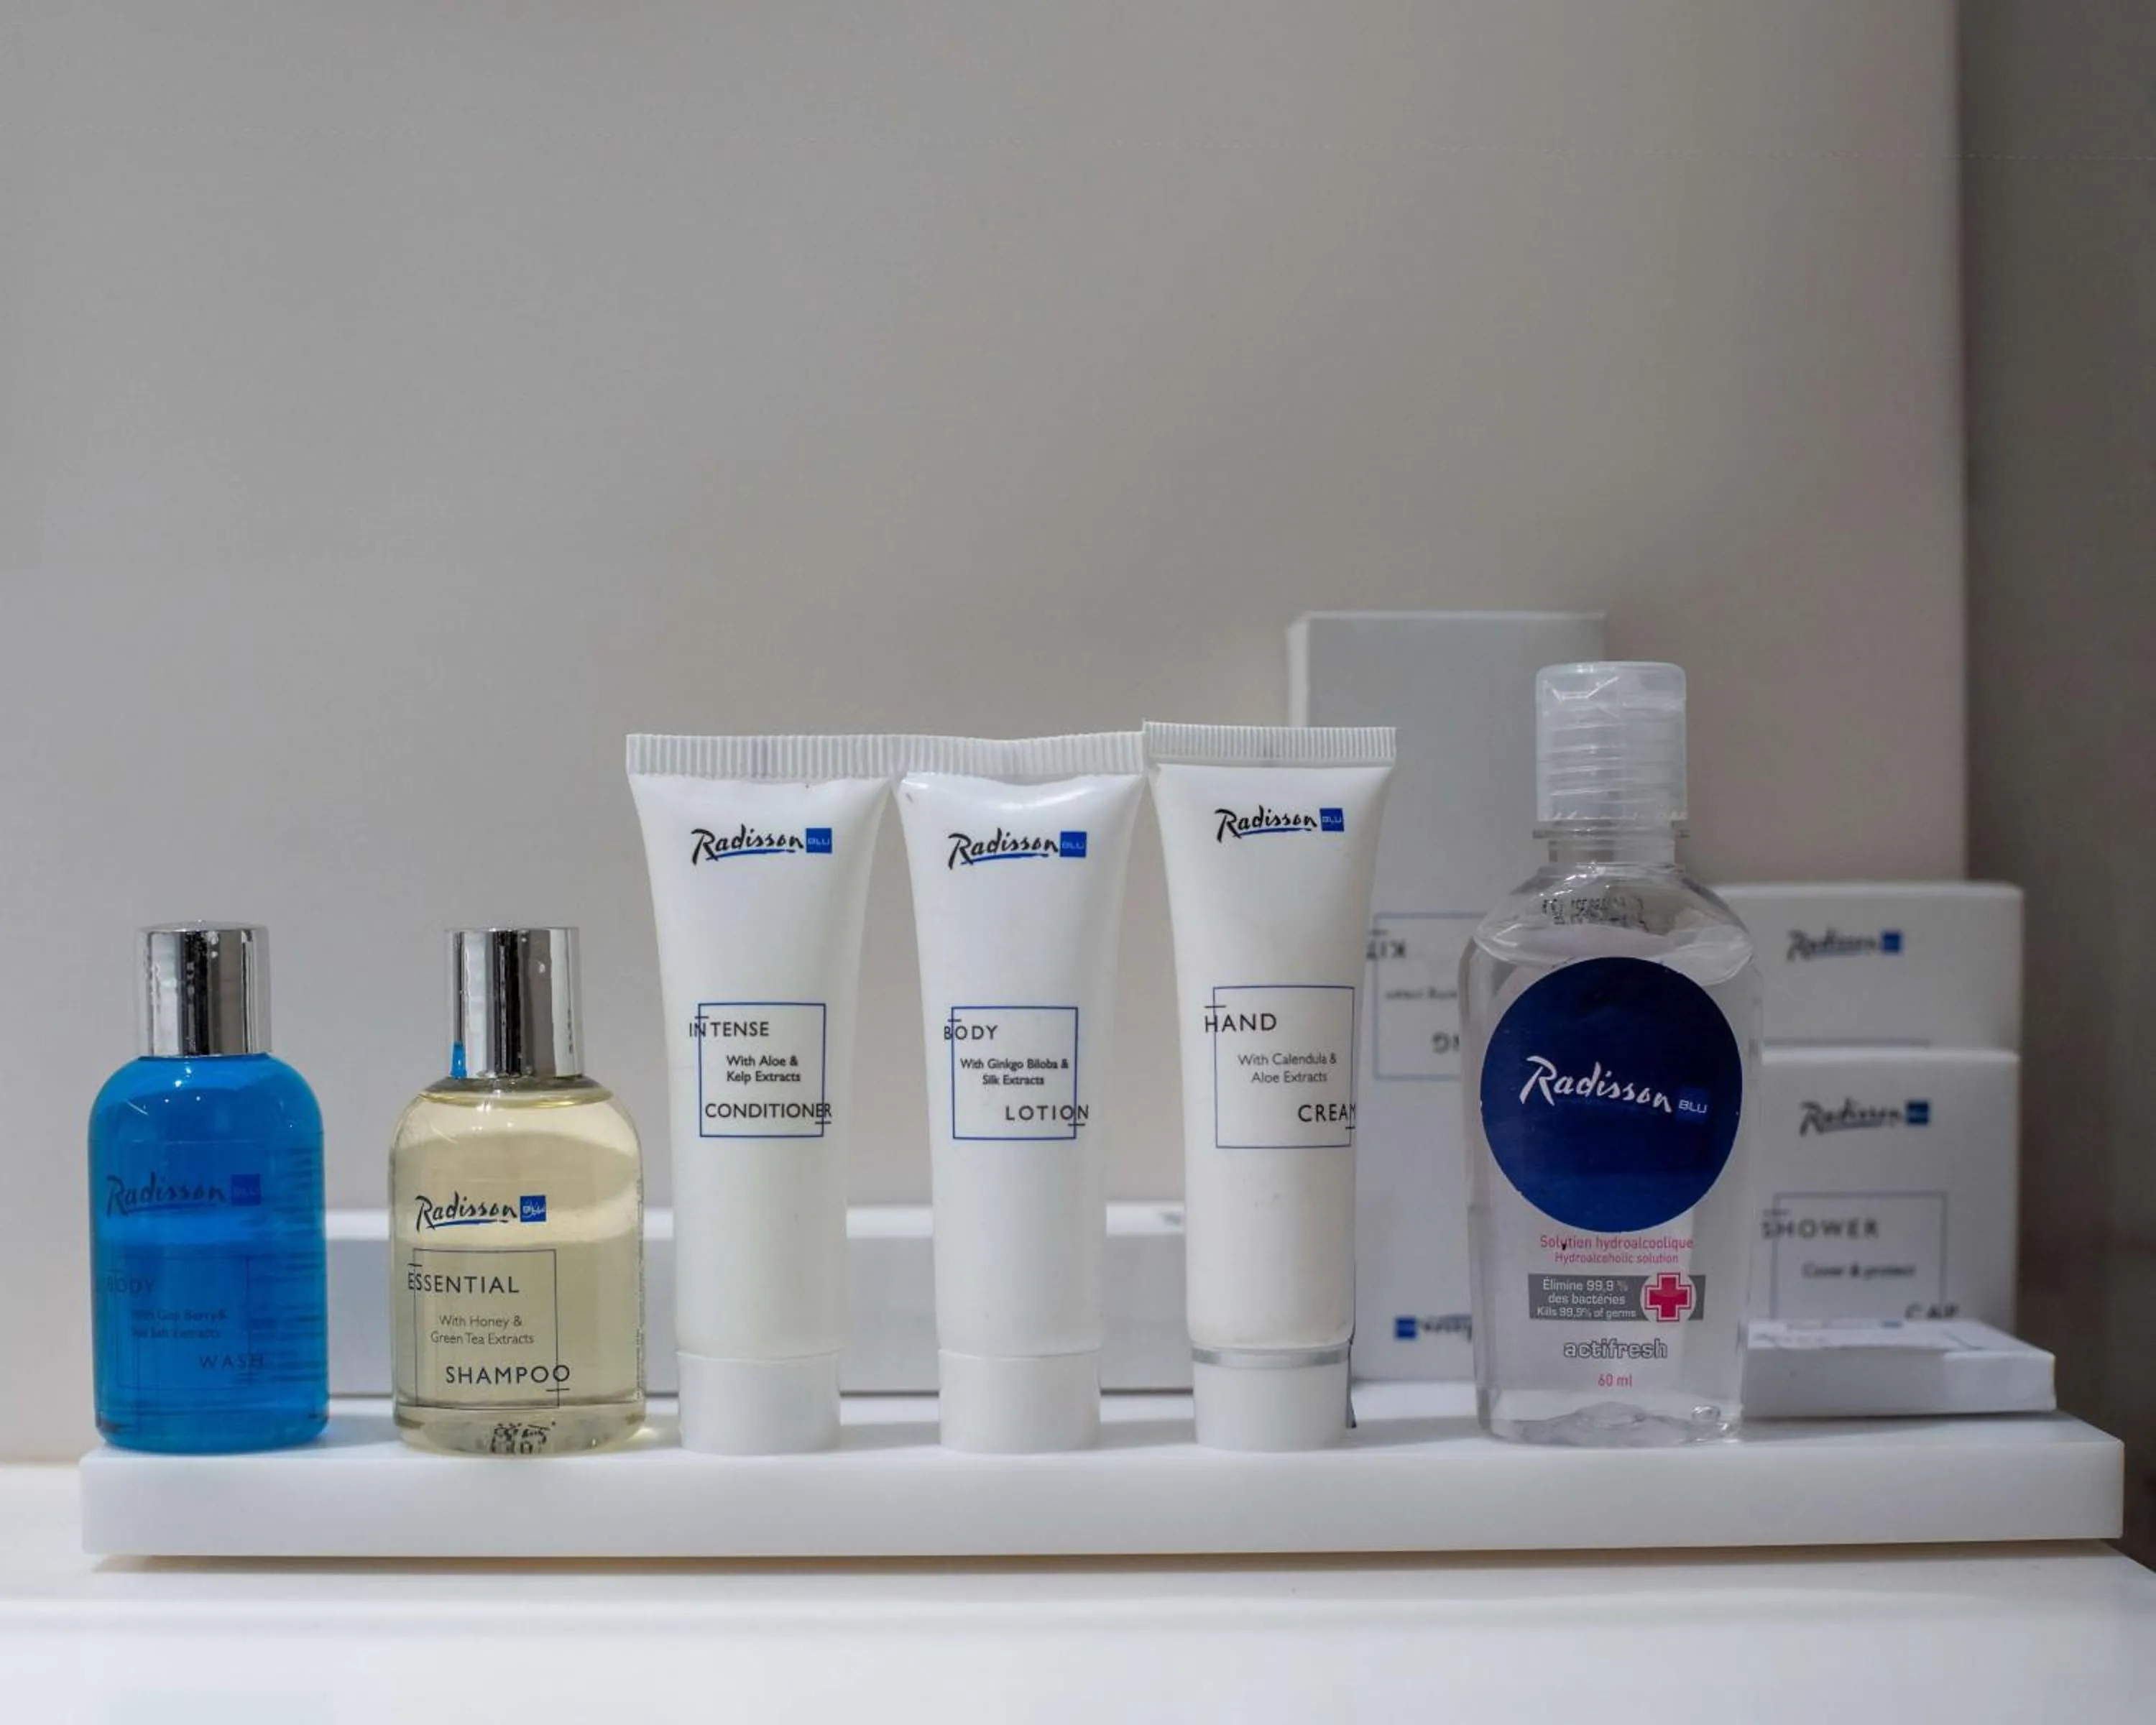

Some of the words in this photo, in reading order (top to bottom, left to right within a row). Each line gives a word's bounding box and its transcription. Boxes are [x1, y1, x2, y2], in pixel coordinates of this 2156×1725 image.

[1214, 804, 1318, 843] Radisson
[690, 823, 804, 866] Radisson
[947, 827, 1059, 870] Radisson
[689, 1021, 770, 1038] INTENSE
[1204, 1013, 1277, 1033] HAND
[944, 1024, 999, 1041] BODY
[726, 1054, 755, 1067] With
[759, 1054, 786, 1067] Aloe
[789, 1054, 799, 1067] &
[959, 1058, 984, 1069] With
[987, 1057, 1024, 1072] Ginkgo
[1027, 1057, 1059, 1069] Biloba
[1061, 1058, 1069, 1069] &
[1237, 1053, 1269, 1065] With
[1271, 1052, 1327, 1065] Calendula
[1329, 1052, 1337, 1064] &
[726, 1070, 752, 1085] Kelp
[755, 1070, 801, 1082] Extracts
[982, 1073, 1000, 1085] Silk
[1003, 1074, 1045, 1085] Extracts
[1250, 1071, 1280, 1083] Aloe
[1283, 1070, 1328, 1083] Extracts
[1519, 1054, 1672, 1113] Radisson
[1678, 1099, 1708, 1114] BLU
[704, 1103, 832, 1119] CONDITIONER
[1005, 1104, 1089, 1121] LOTION
[1297, 1103, 1356, 1122] CREAM
[106, 1171, 226, 1218] Radisson
[415, 1190, 518, 1233] Radisson
[1761, 1217, 1879, 1240] SHOWER
[1539, 1234, 1592, 1250] Solution
[1595, 1235, 1695, 1251] hydroalcoolique
[1554, 1251, 1634, 1265] Hydroalcoholic
[1636, 1252, 1680, 1264] solution
[407, 1271, 520, 1294] ESSENTIAL
[1542, 1276, 1584, 1291] Élimine
[1547, 1293, 1570, 1304] des
[1572, 1292, 1626, 1305] bactéries
[1537, 1305, 1558, 1317] Kills
[1593, 1307, 1605, 1317] of
[1606, 1309, 1637, 1320] germs
[438, 1315, 466, 1327] With
[469, 1315, 510, 1329] Honey
[513, 1315, 523, 1328] &
[430, 1330, 464, 1345] Green
[465, 1332, 486, 1346] Tea
[488, 1332, 535, 1346] Extracts
[1563, 1337, 1668, 1359] actifresh
[199, 1351, 264, 1370] WASH
[445, 1364, 571, 1384] SHAMPOO
[1598, 1373, 1614, 1386] 60
[1616, 1373, 1633, 1387] ml
